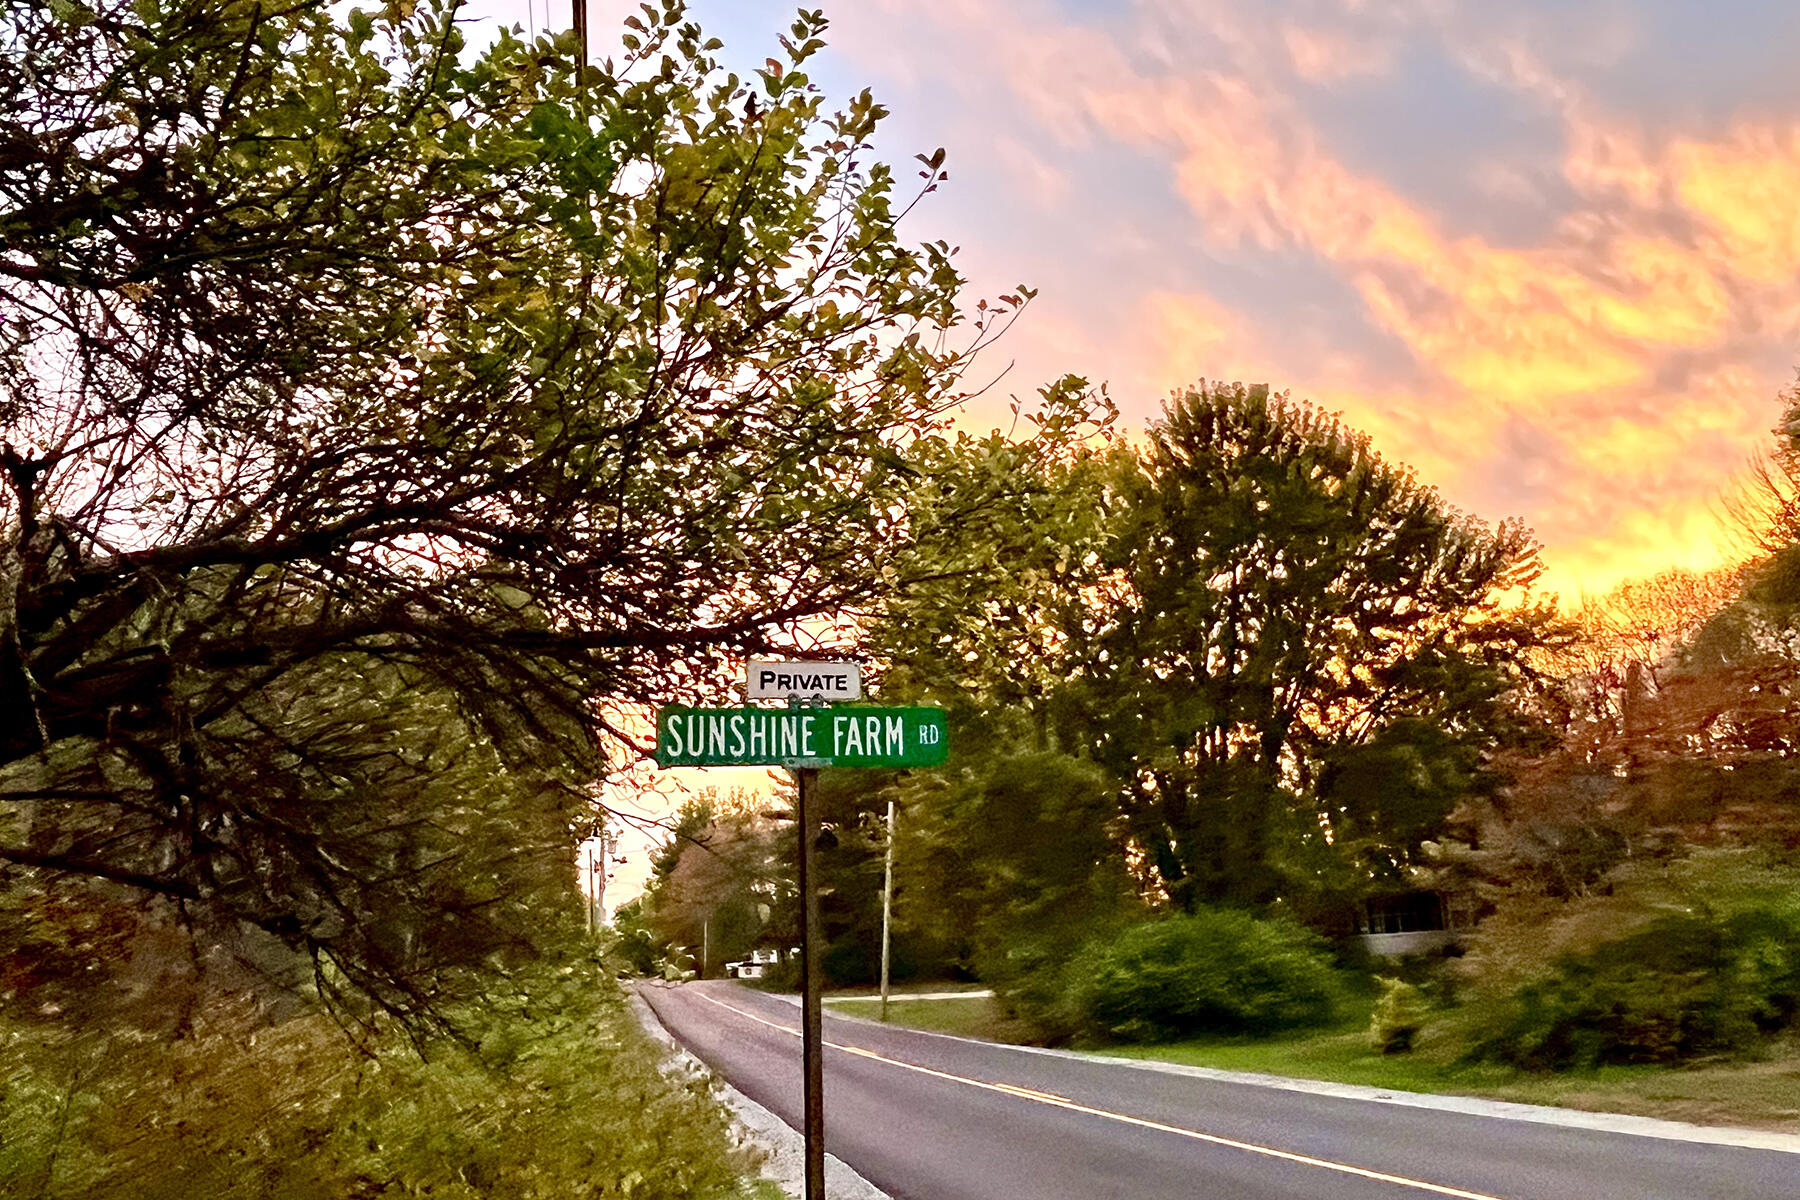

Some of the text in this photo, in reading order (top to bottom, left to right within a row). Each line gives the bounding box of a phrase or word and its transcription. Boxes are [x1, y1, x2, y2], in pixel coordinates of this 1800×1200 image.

[760, 671, 848, 691] PRIVATE
[667, 714, 939, 757] SUNSHINE FARM RD
